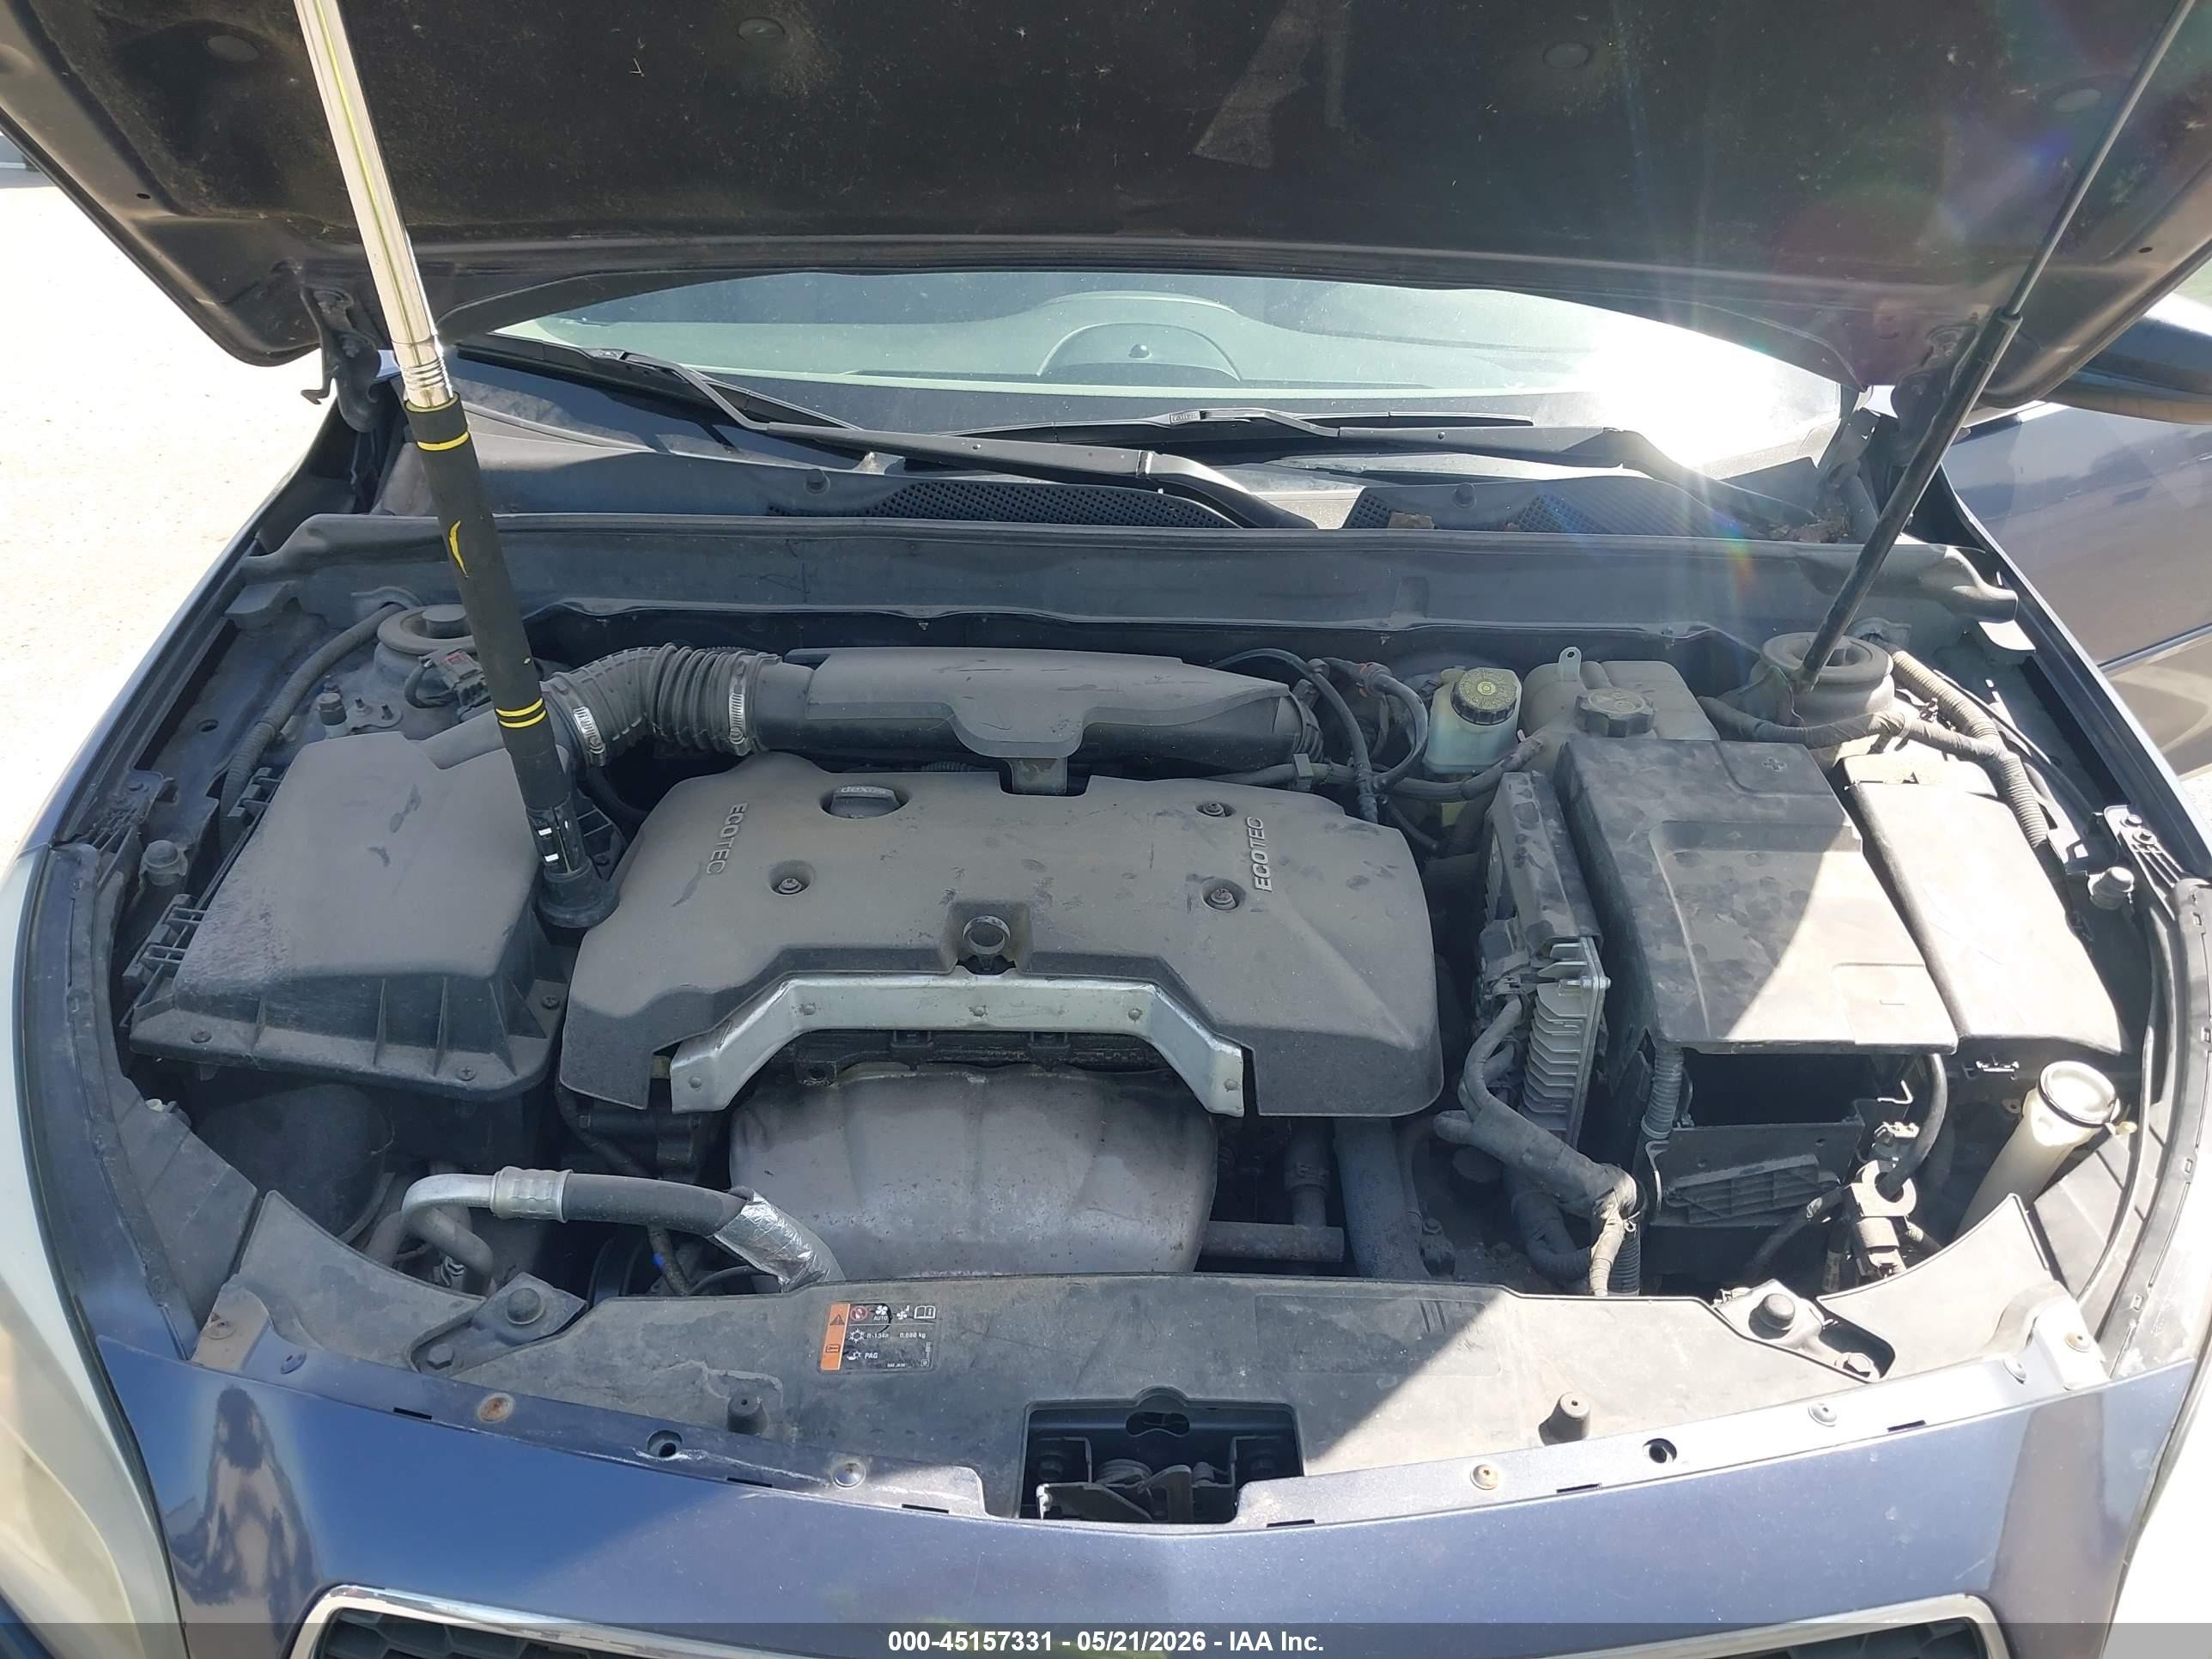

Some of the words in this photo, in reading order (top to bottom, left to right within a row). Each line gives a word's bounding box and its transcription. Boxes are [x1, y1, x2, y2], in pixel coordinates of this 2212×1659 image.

[706, 802, 749, 875] ECOTEC
[1246, 817, 1273, 893] ECOTEC
[864, 1352, 878, 1360] PAG
